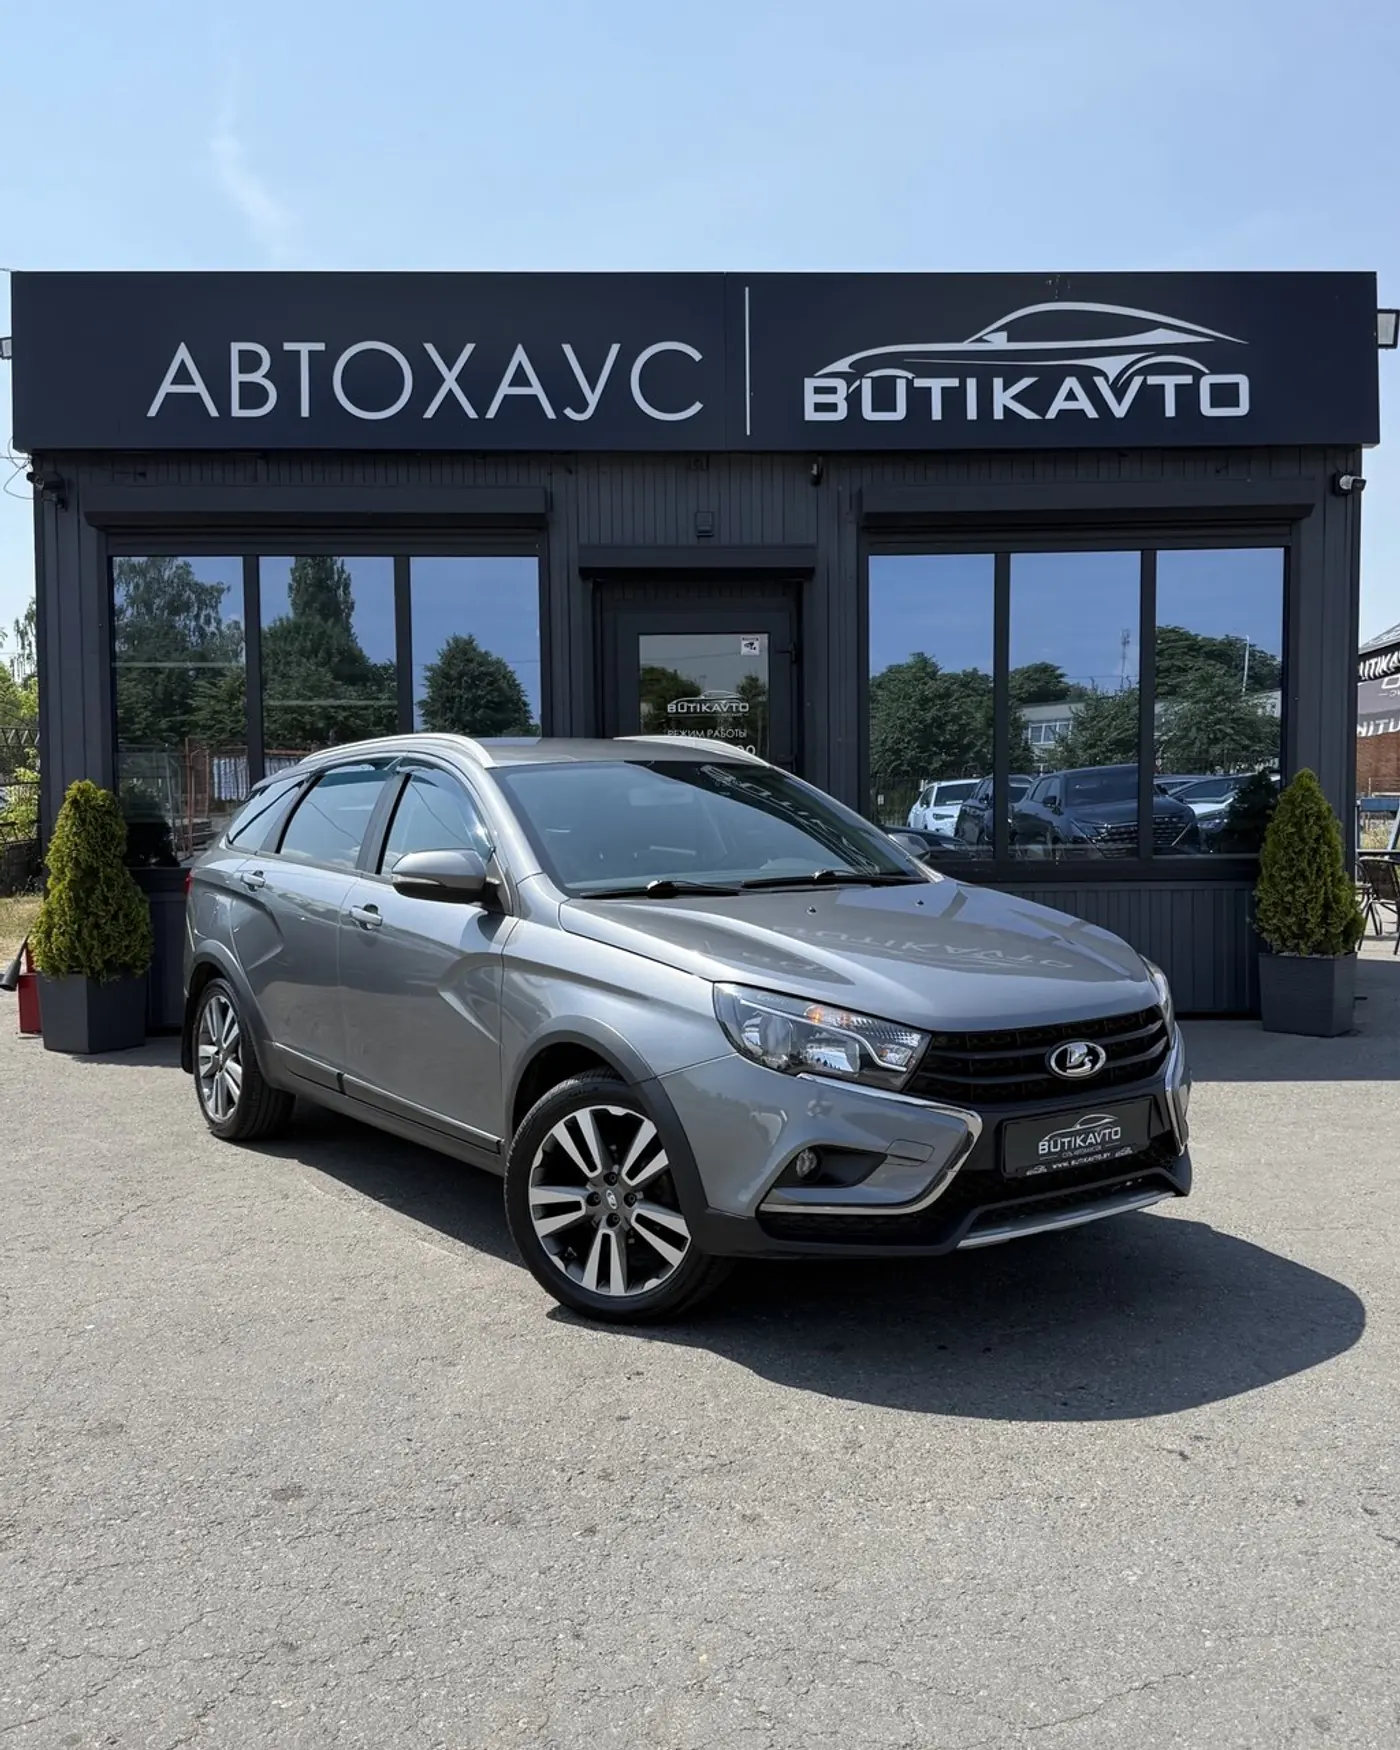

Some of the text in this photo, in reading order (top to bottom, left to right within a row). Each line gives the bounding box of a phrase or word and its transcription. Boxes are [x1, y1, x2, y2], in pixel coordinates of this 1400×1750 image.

[147, 341, 703, 420] АВТОХАУС
[803, 374, 1250, 421] BUTIKAVTO
[667, 702, 749, 713] BUTIKAVTO
[667, 728, 747, 738] РЕЖИМ РАБОТЫ
[1038, 1127, 1121, 1154] BUTIKAVTO
